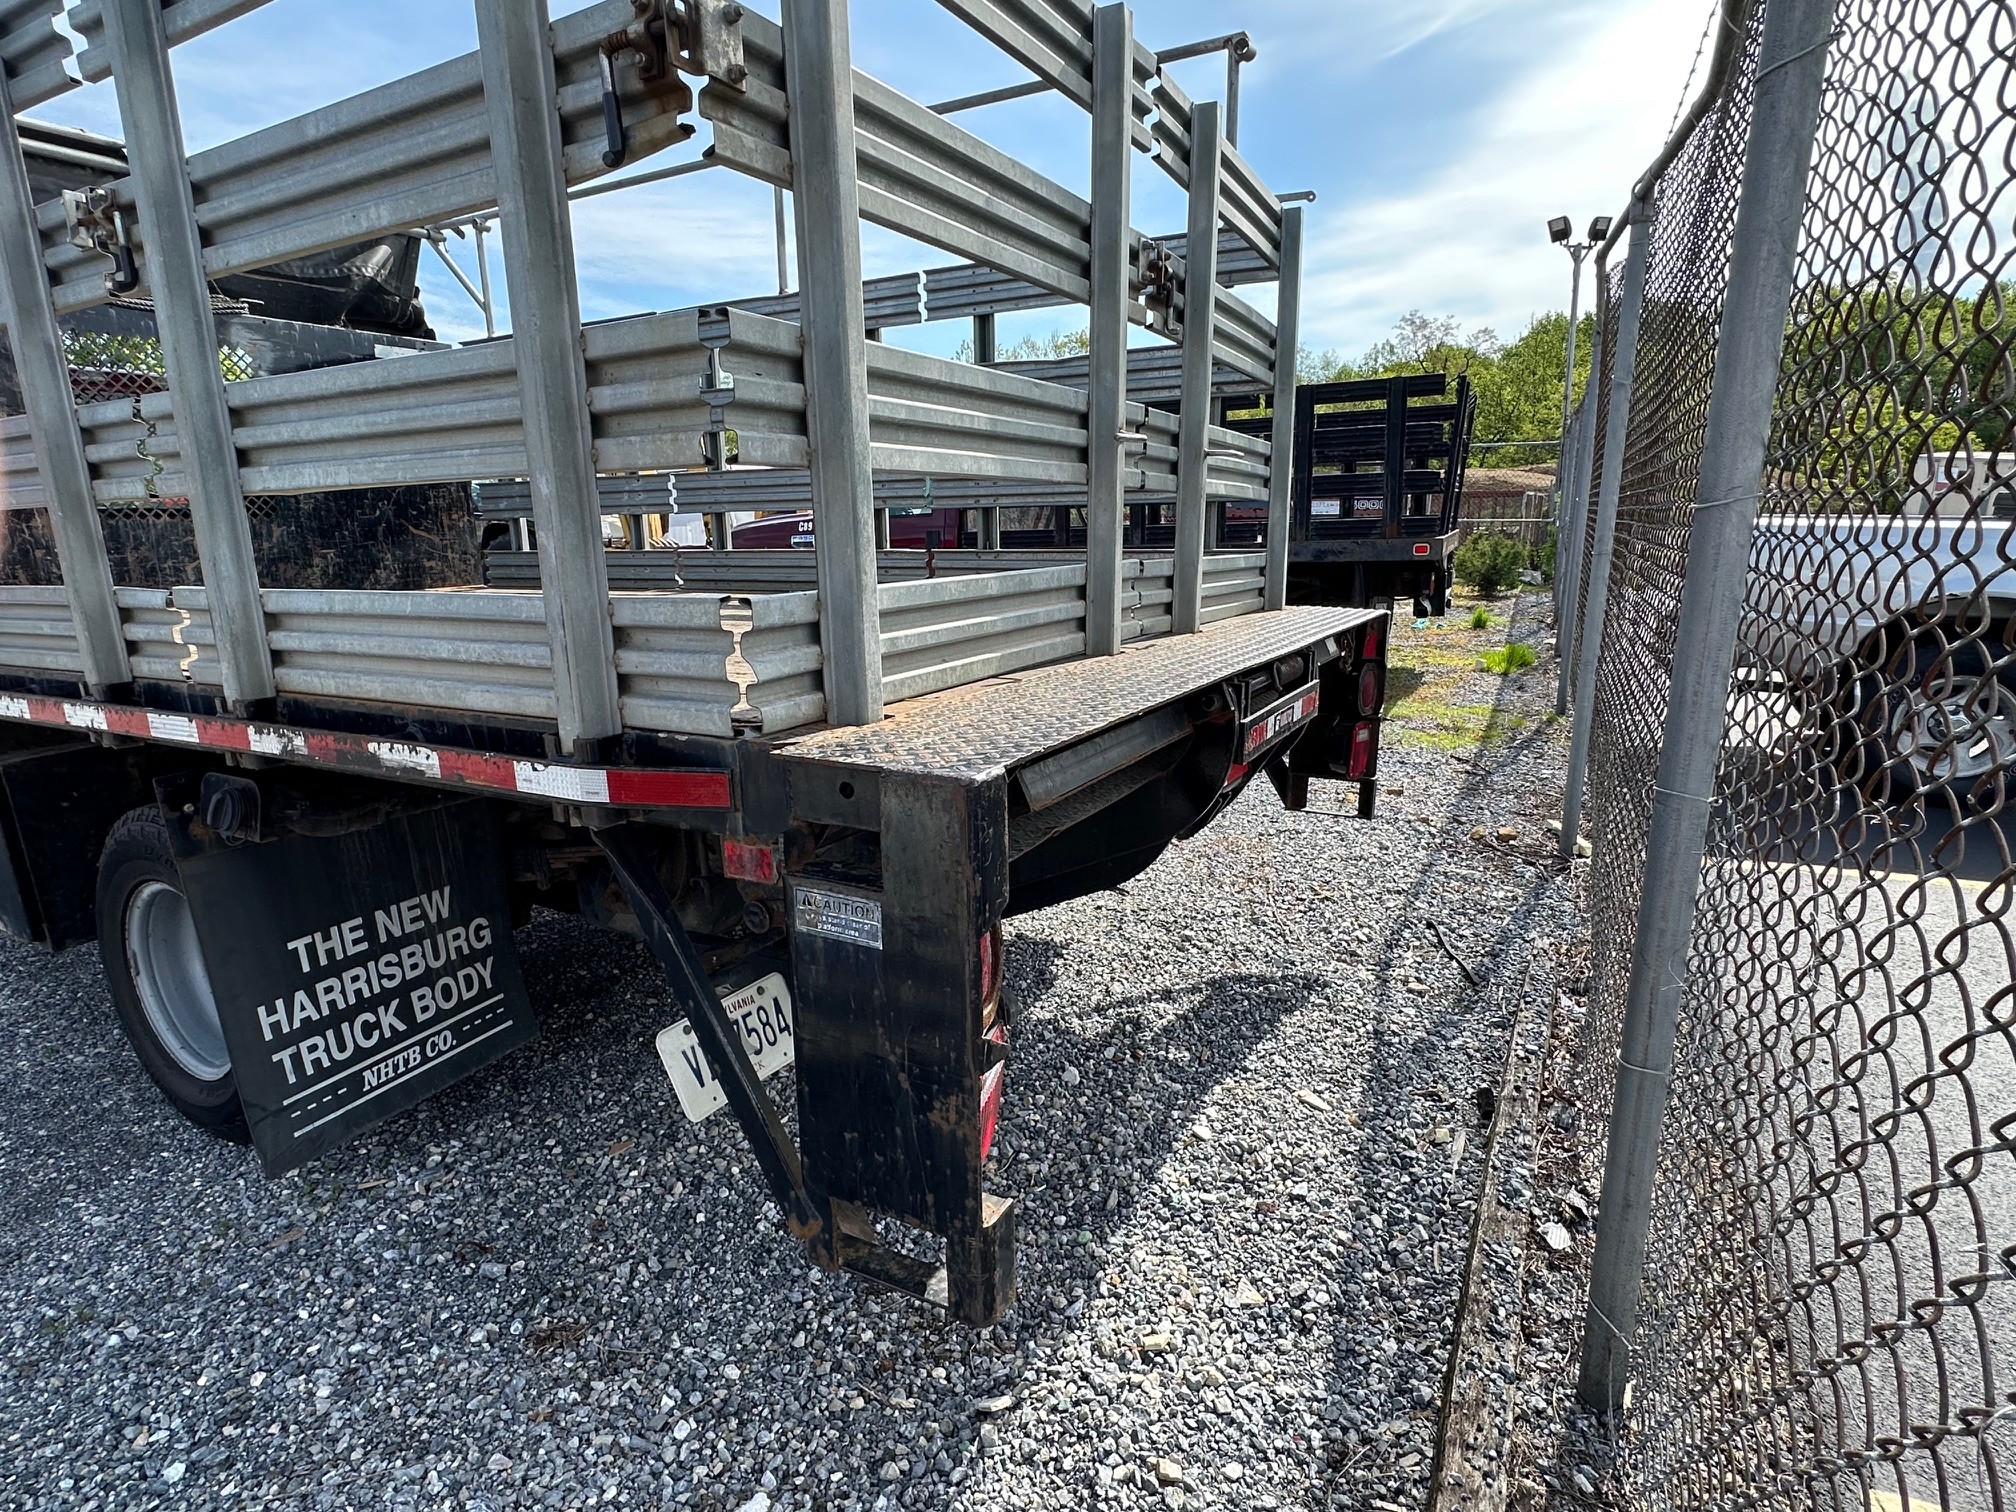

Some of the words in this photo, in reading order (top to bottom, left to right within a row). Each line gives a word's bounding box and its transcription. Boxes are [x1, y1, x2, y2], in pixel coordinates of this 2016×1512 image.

[287, 916, 369, 973] THE
[374, 885, 451, 944] NEW
[813, 896, 875, 919] CAUTION
[256, 917, 493, 1042] HARRISBURG
[271, 998, 408, 1085] TRUCK
[410, 955, 495, 1023] BODY
[361, 1045, 422, 1092] NHTB
[425, 1029, 457, 1058] CO.
